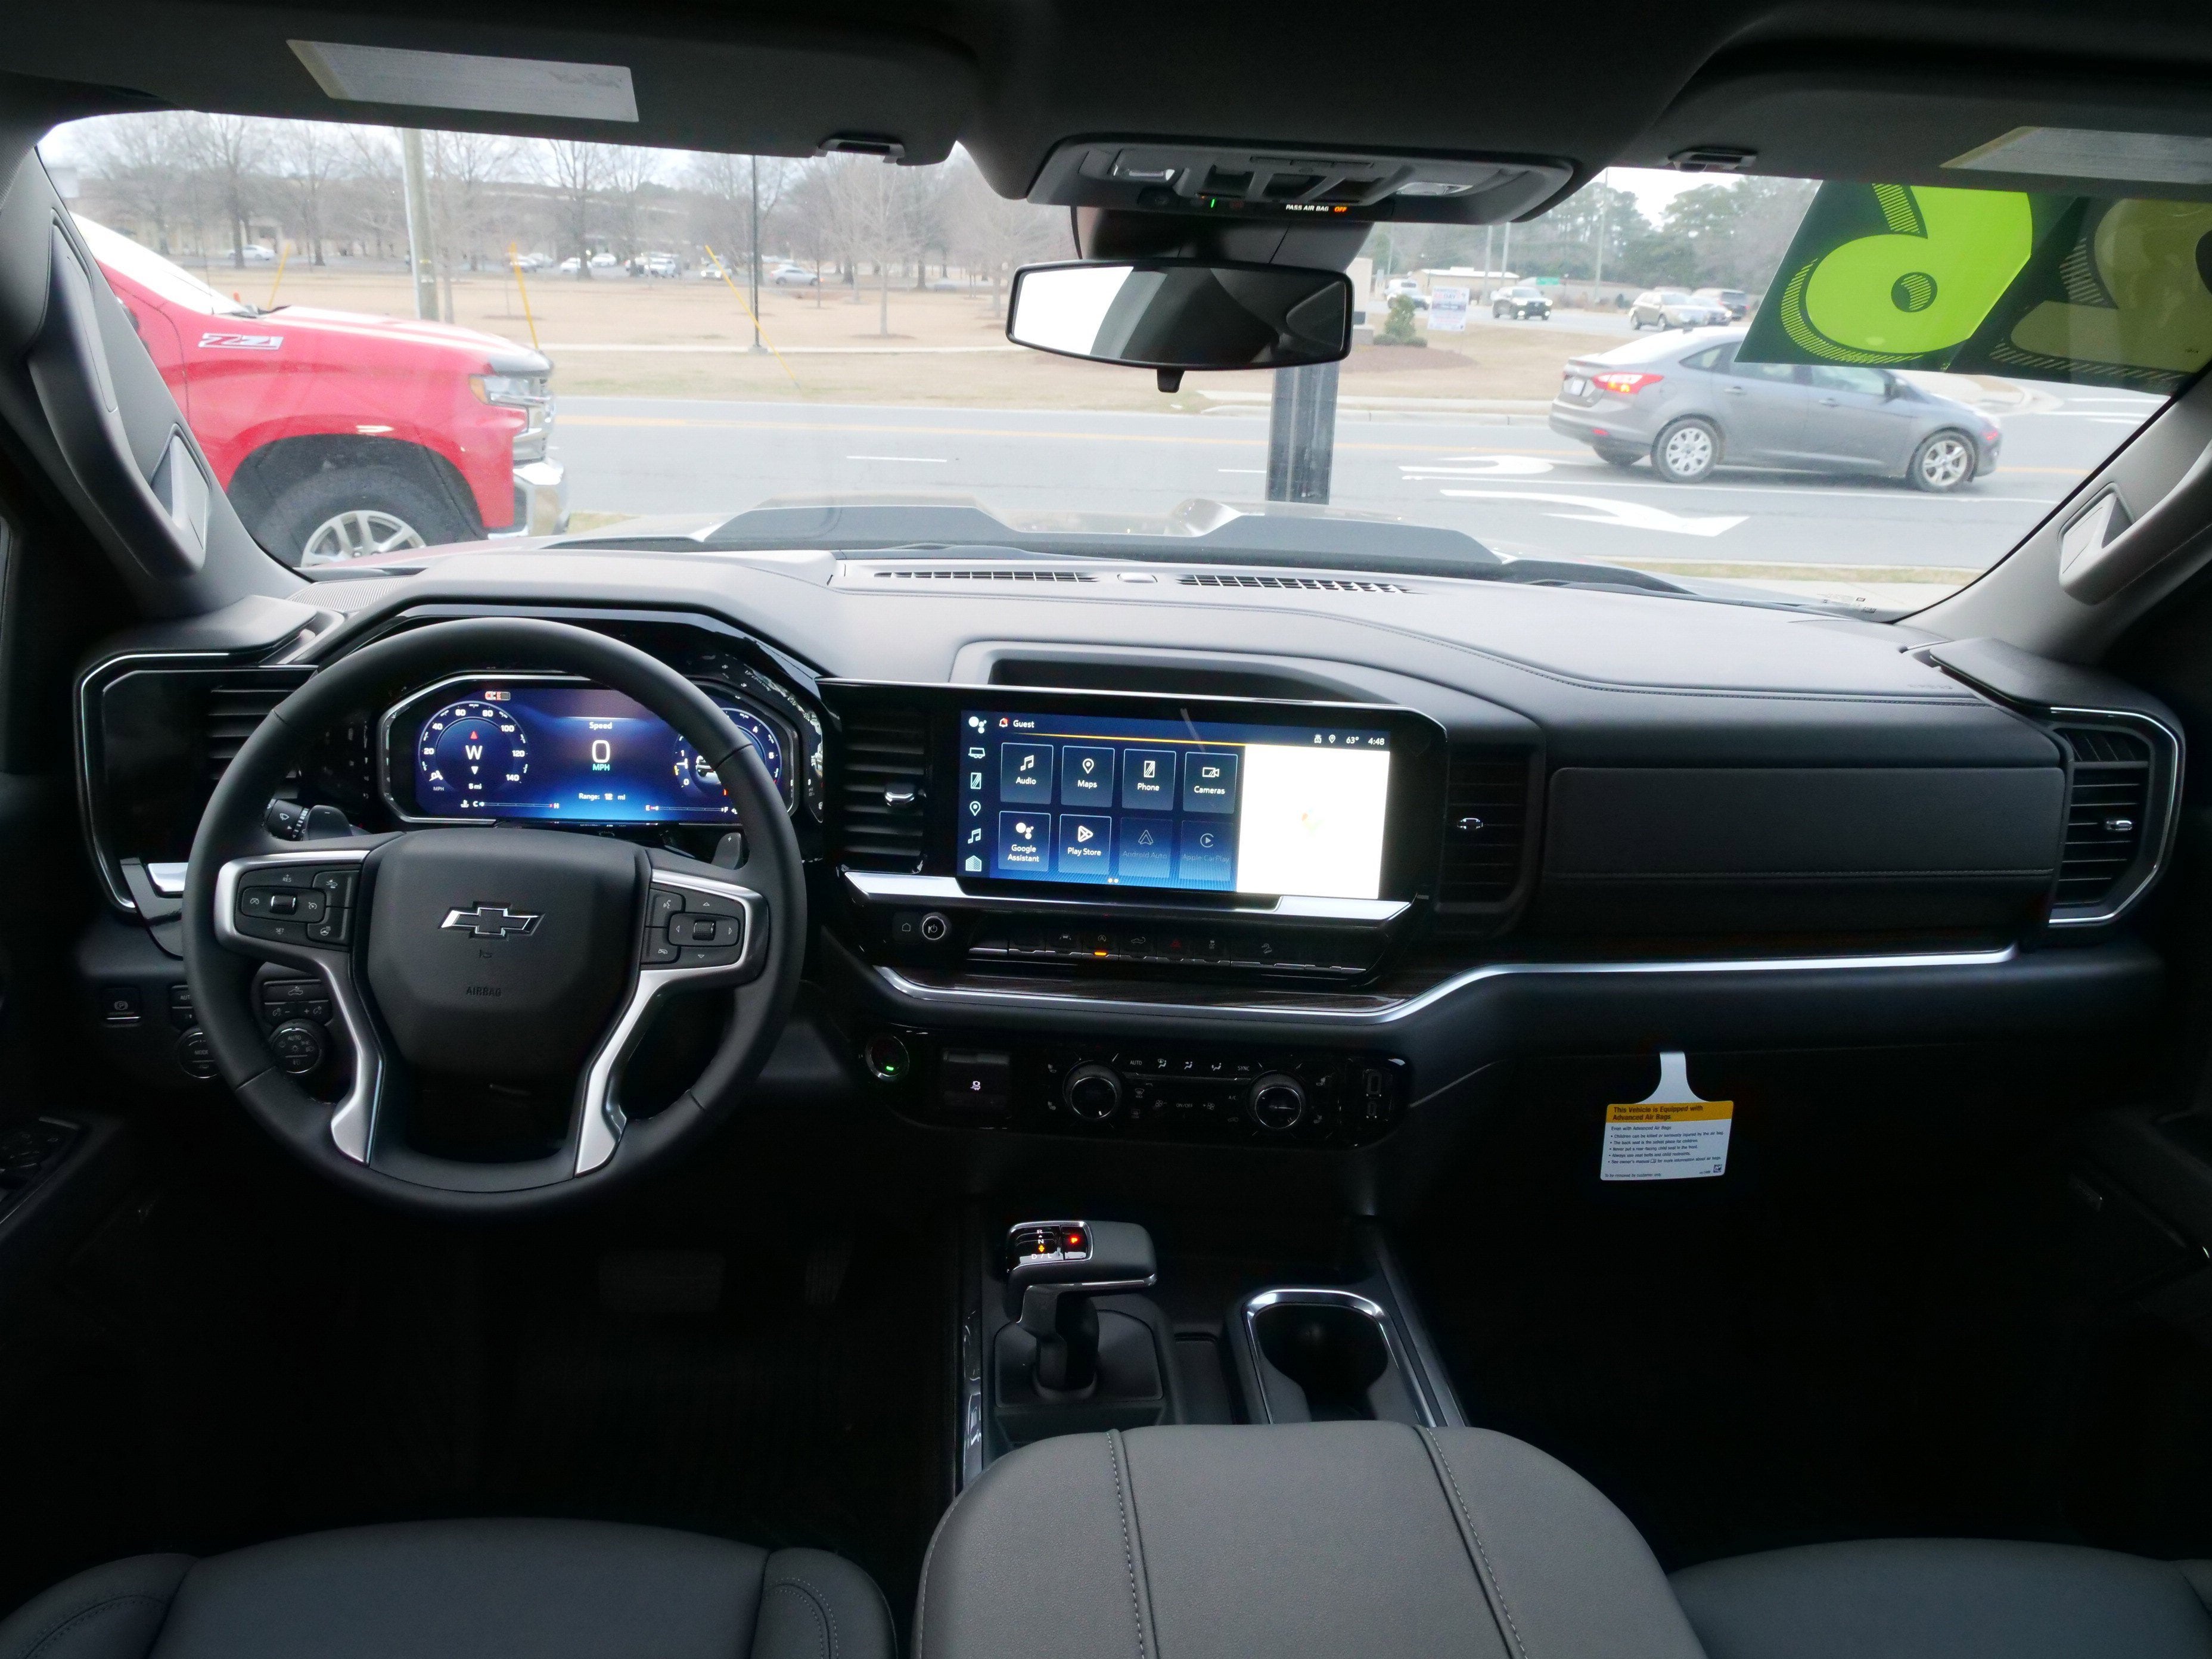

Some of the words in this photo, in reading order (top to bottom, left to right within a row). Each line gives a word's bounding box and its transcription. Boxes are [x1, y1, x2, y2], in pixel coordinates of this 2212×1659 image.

[589, 721, 613, 731] Speed
[1013, 719, 1034, 728] Guest
[1368, 737, 1385, 745] 4:48
[465, 745, 483, 760] W
[592, 740, 611, 763] 0
[1015, 776, 1037, 785] Audio
[1077, 779, 1098, 789] Maps
[1137, 782, 1160, 791] Phone
[1194, 785, 1226, 794] Cameras
[579, 793, 600, 801] Range:
[1011, 844, 1037, 854] Google
[1067, 847, 1082, 857] Play
[1083, 847, 1102, 856] Store
[1007, 853, 1040, 862] Assistant
[466, 986, 502, 997] AIRBAG
